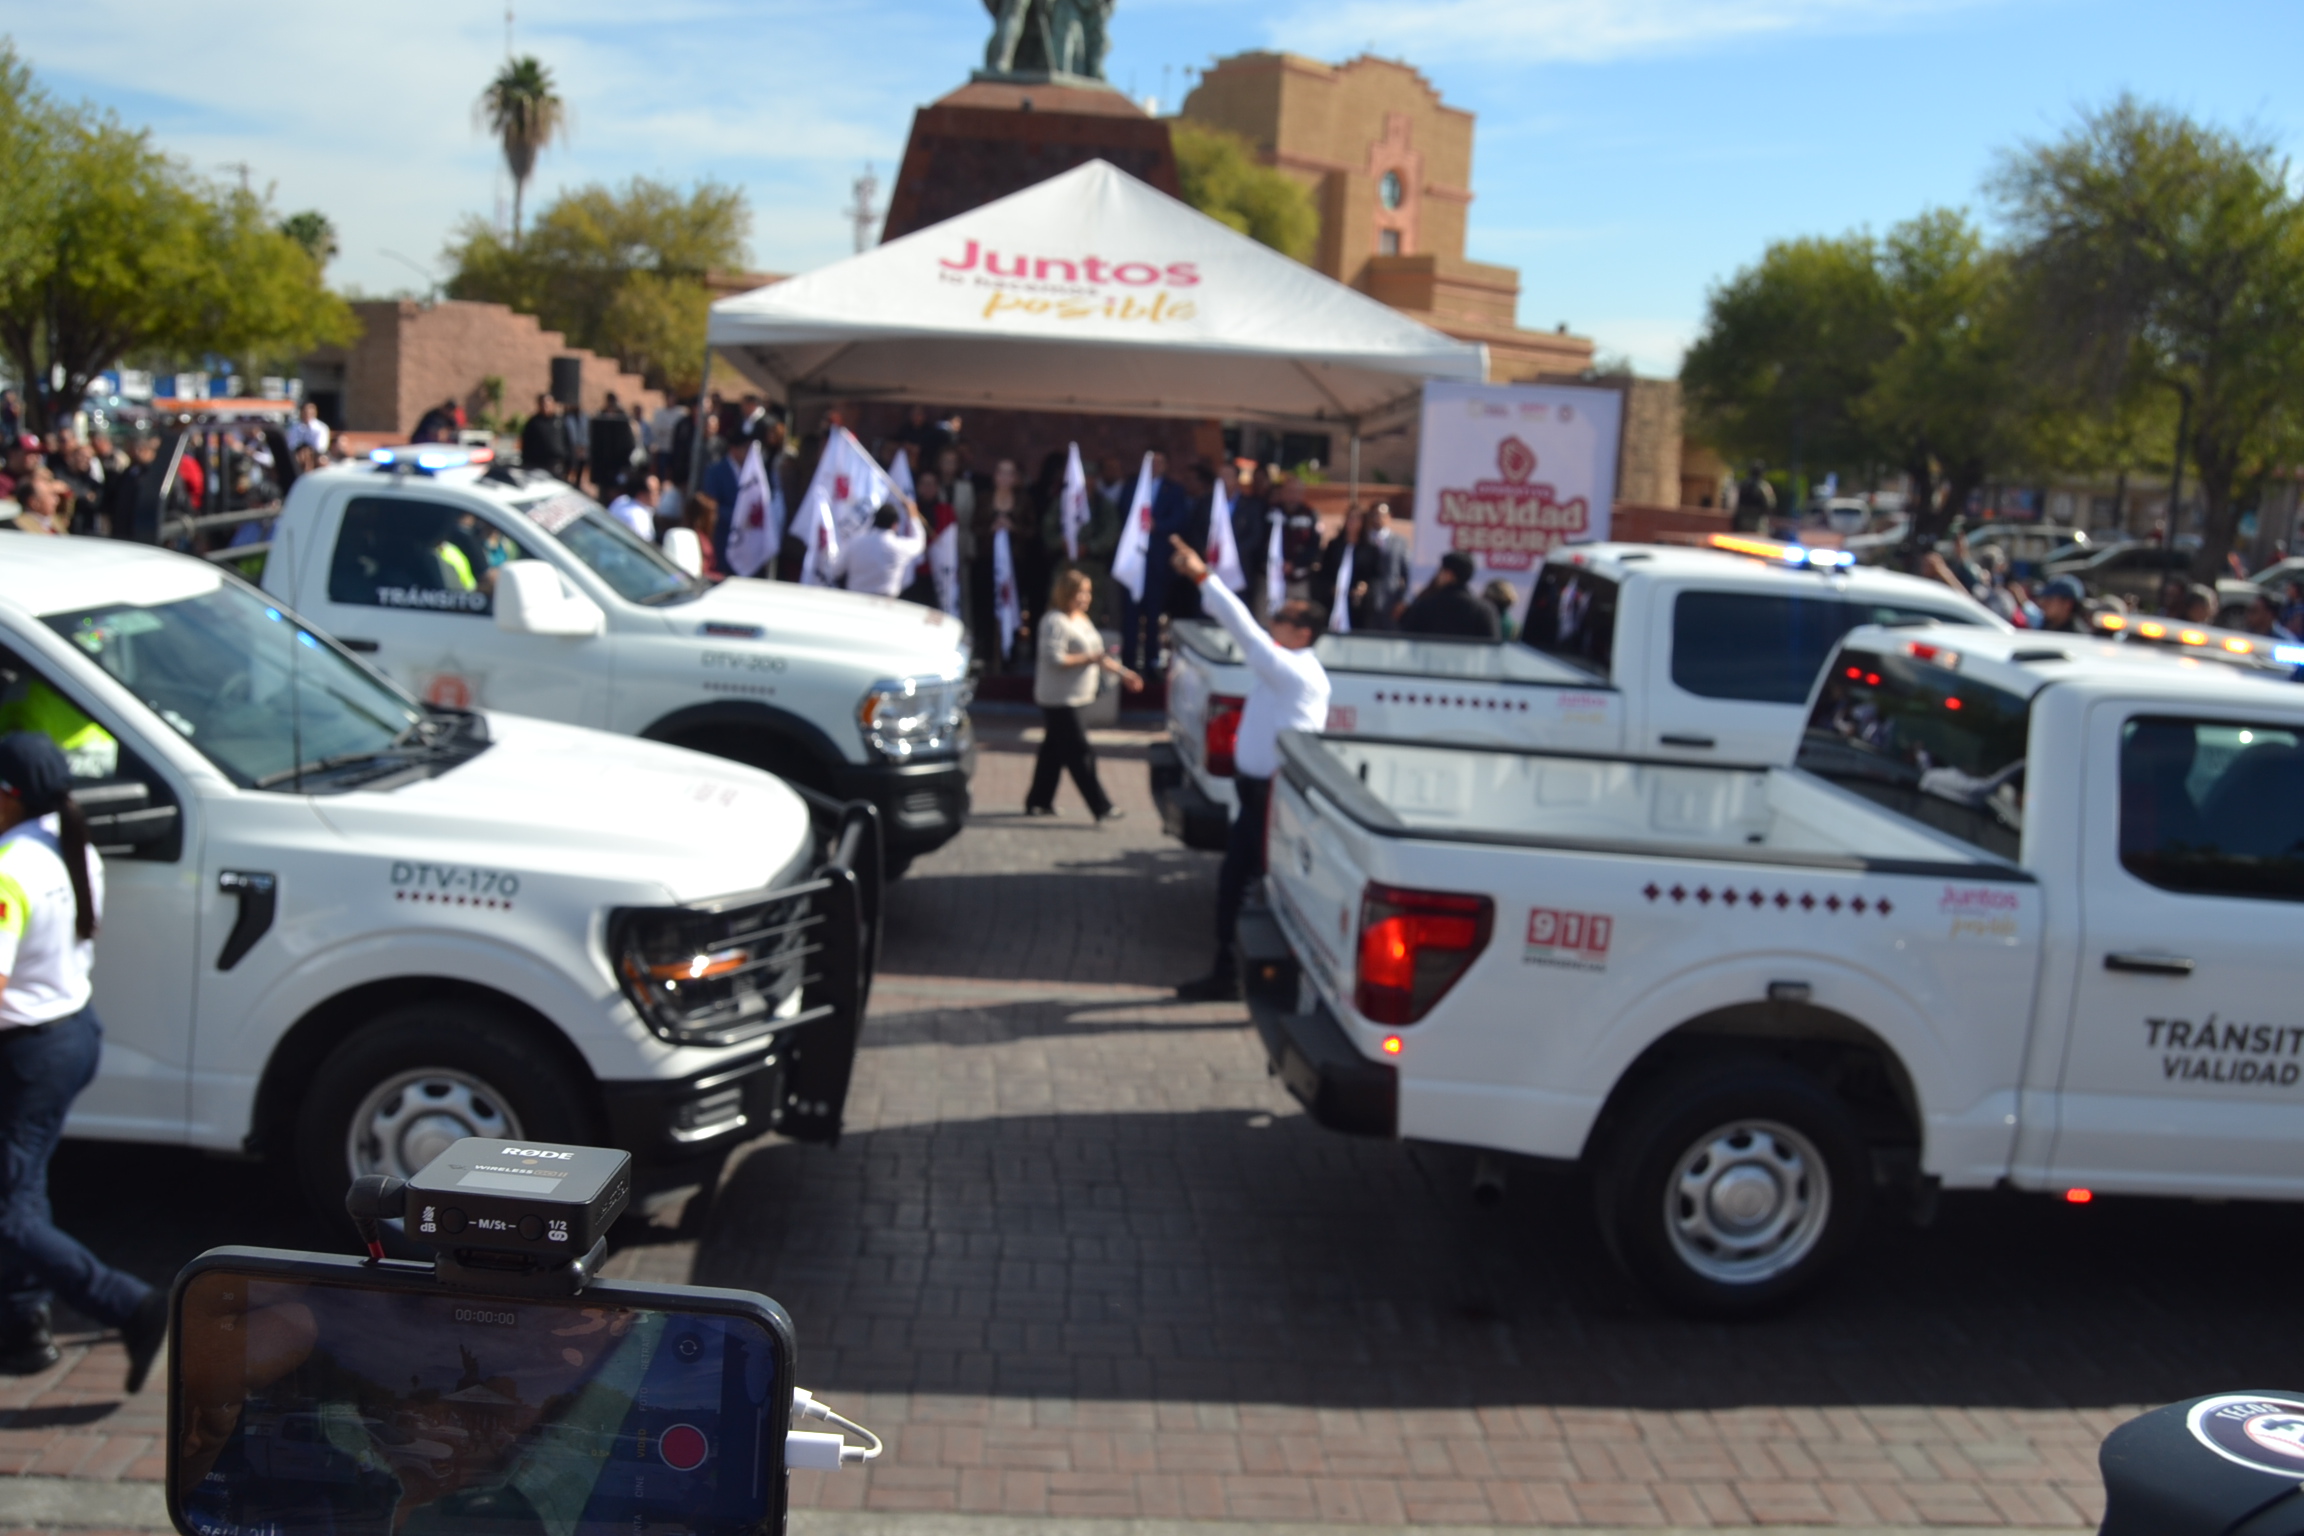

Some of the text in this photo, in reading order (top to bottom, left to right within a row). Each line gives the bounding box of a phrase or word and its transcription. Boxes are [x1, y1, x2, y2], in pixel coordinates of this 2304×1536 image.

[939, 238, 1202, 287] Juntos
[982, 290, 1198, 322] posible
[1442, 491, 1584, 530] Navidad
[376, 584, 488, 610] TRÁNSITO
[390, 860, 520, 897] DTV-170
[1531, 909, 1609, 949] 911
[2144, 1012, 2304, 1056] TRÁNSIT
[2163, 1055, 2300, 1086] VIALIDAD
[474, 1164, 534, 1175] WIRELESS
[419, 1222, 437, 1233] dB
[478, 1219, 507, 1231] M/St
[549, 1219, 568, 1230] 1/2
[220, 1322, 235, 1332] HD
[455, 1308, 515, 1325] 00:00:00
[639, 1386, 649, 1412] FOTO
[2215, 1403, 2284, 1421] TECOS
[637, 1428, 647, 1458] VIDEO
[635, 1475, 645, 1498] CINE
